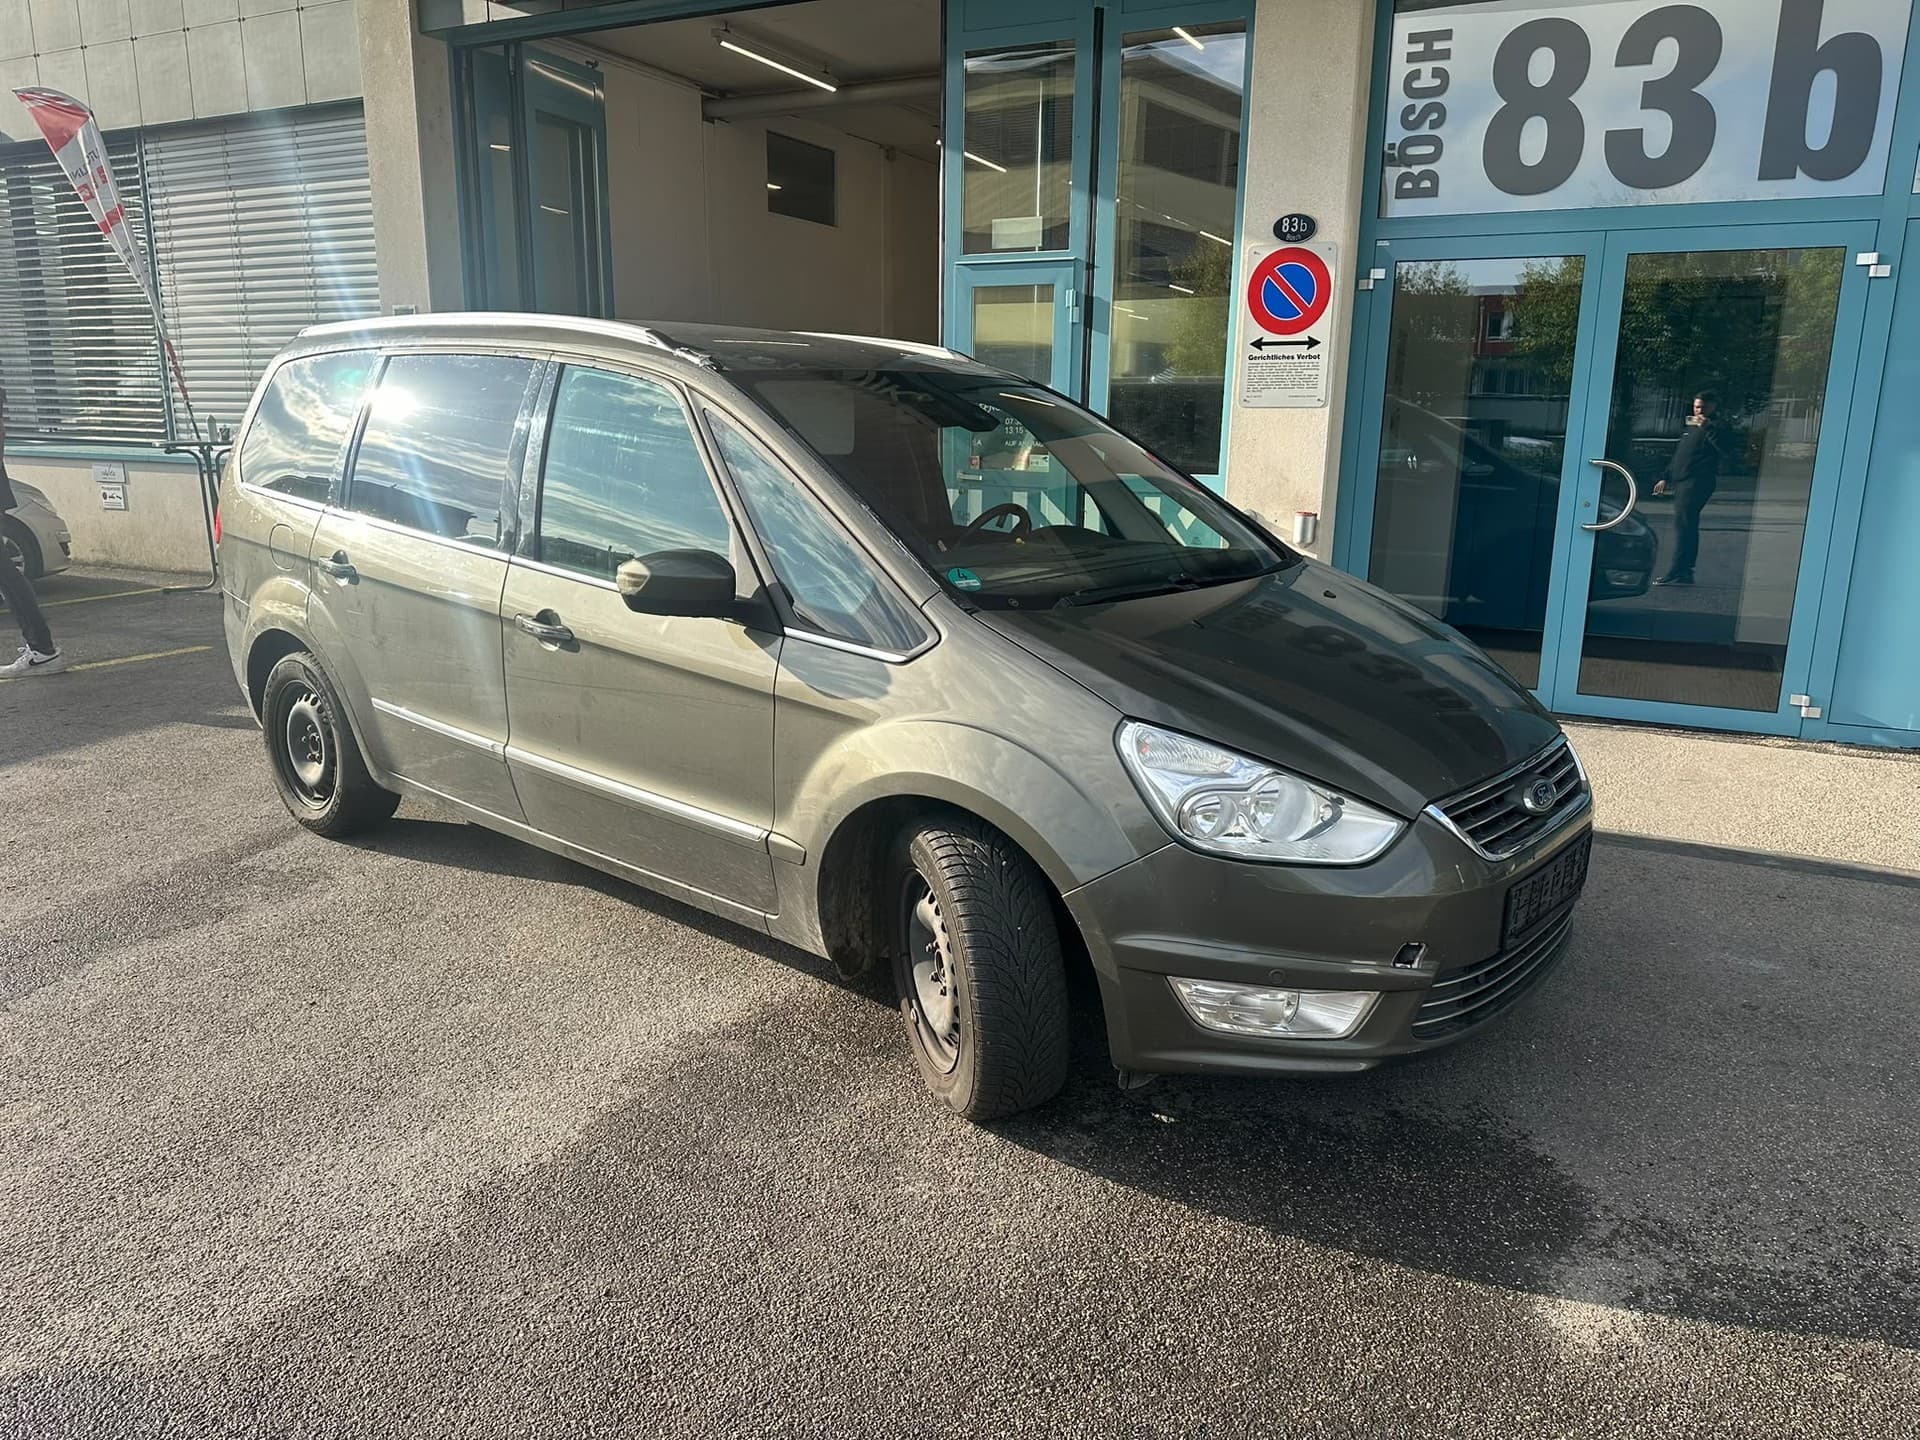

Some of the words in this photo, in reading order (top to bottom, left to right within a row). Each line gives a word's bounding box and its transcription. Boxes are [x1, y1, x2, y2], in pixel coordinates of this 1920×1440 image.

[1384, 28, 1454, 200] BÖSCH
[1281, 217, 1308, 233] 83b
[1248, 353, 1295, 361] Gerichtliches
